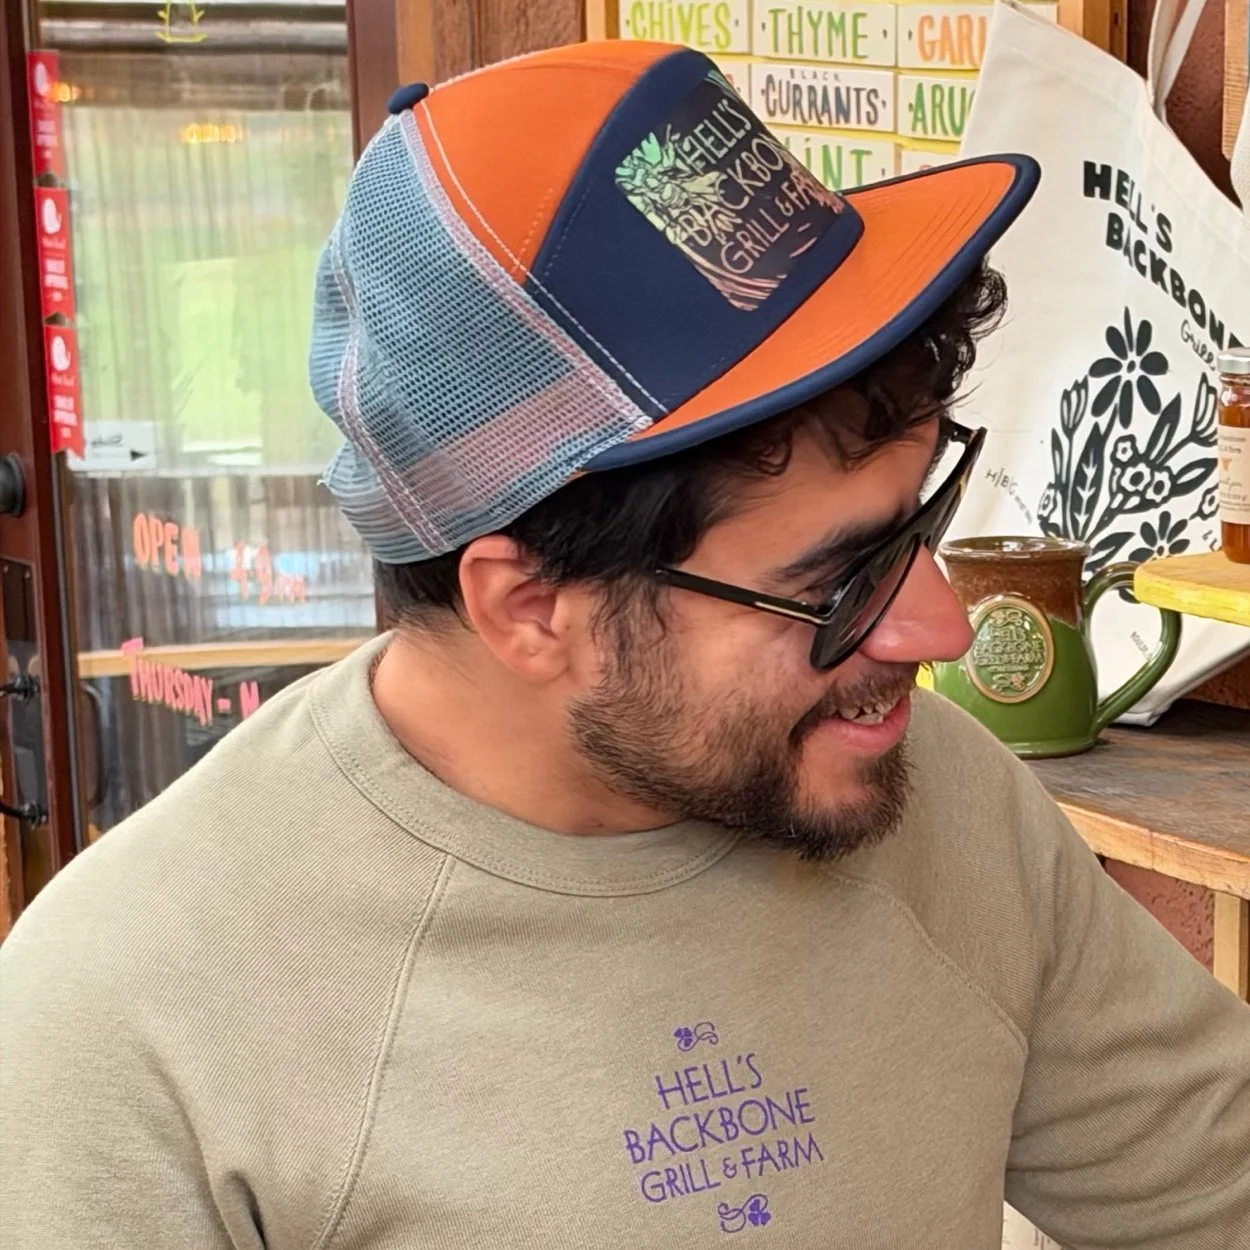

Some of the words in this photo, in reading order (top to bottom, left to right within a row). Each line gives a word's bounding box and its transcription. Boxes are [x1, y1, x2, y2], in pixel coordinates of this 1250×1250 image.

[768, 5, 869, 60] THYME
[765, 73, 880, 126] CURRANTS
[789, 68, 843, 82] BLACK
[675, 98, 752, 175] HELL'S
[720, 208, 790, 274] GRILL
[774, 196, 794, 217] &
[1083, 160, 1173, 253] HELL'S
[133, 511, 203, 581] OPEN
[121, 636, 214, 727] THURSDAY
[655, 1053, 763, 1110] HELL'S
[623, 1087, 816, 1164] BACKBONE
[641, 1159, 721, 1203] GRILL
[722, 1157, 738, 1179] &
[740, 1132, 825, 1179] FARM
